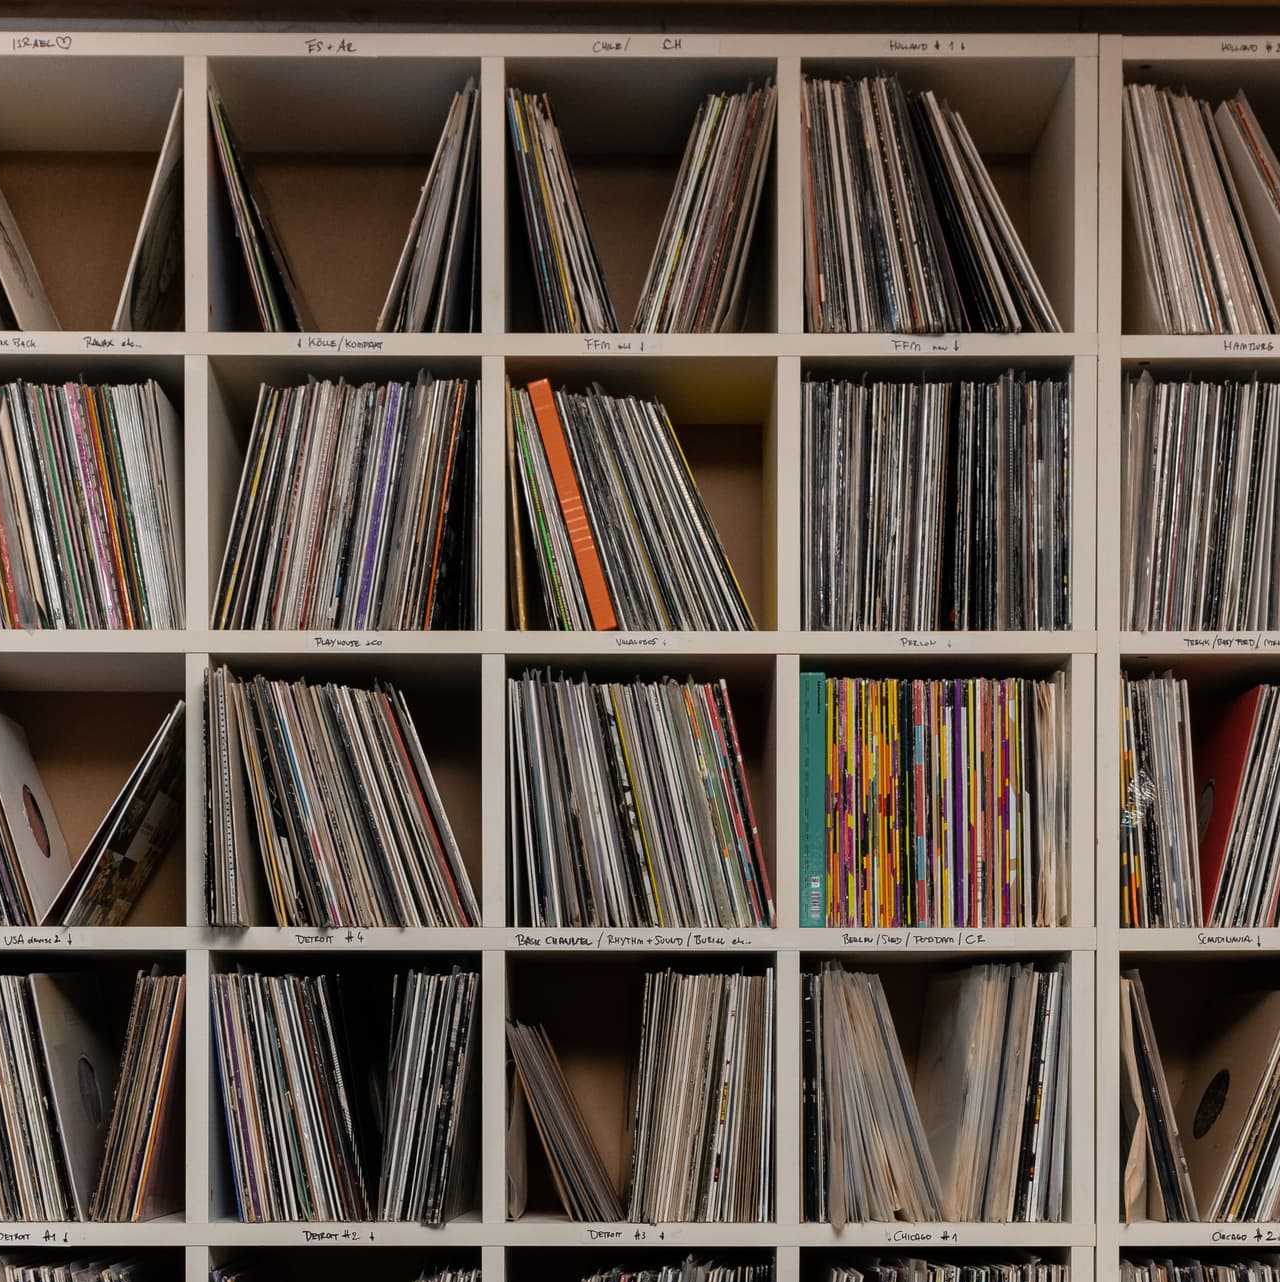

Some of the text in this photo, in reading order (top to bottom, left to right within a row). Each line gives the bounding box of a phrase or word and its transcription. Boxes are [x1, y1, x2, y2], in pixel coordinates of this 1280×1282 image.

[13, 37, 55, 50] ISRAEL
[305, 39, 323, 53] ES
[890, 40, 928, 51] HOLLAND
[1221, 43, 1258, 52] HOLLAND
[1224, 340, 1274, 351] HAMBURG
[314, 637, 360, 647] PLAYHOUSE
[900, 637, 936, 647] PERLON
[4, 934, 24, 946] USA
[54, 935, 61, 943] 2
[296, 932, 334, 944] DETROIT
[345, 930, 354, 943] #
[545, 936, 592, 946] CHANNEL
[607, 935, 643, 946] RHYTHM
[842, 934, 873, 944] BERLIN
[302, 1231, 339, 1242] DETROIT
[587, 1230, 622, 1240] DETROIT
[894, 1231, 932, 1241] CHICAGO
[1212, 1232, 1247, 1241] CHICAGO
